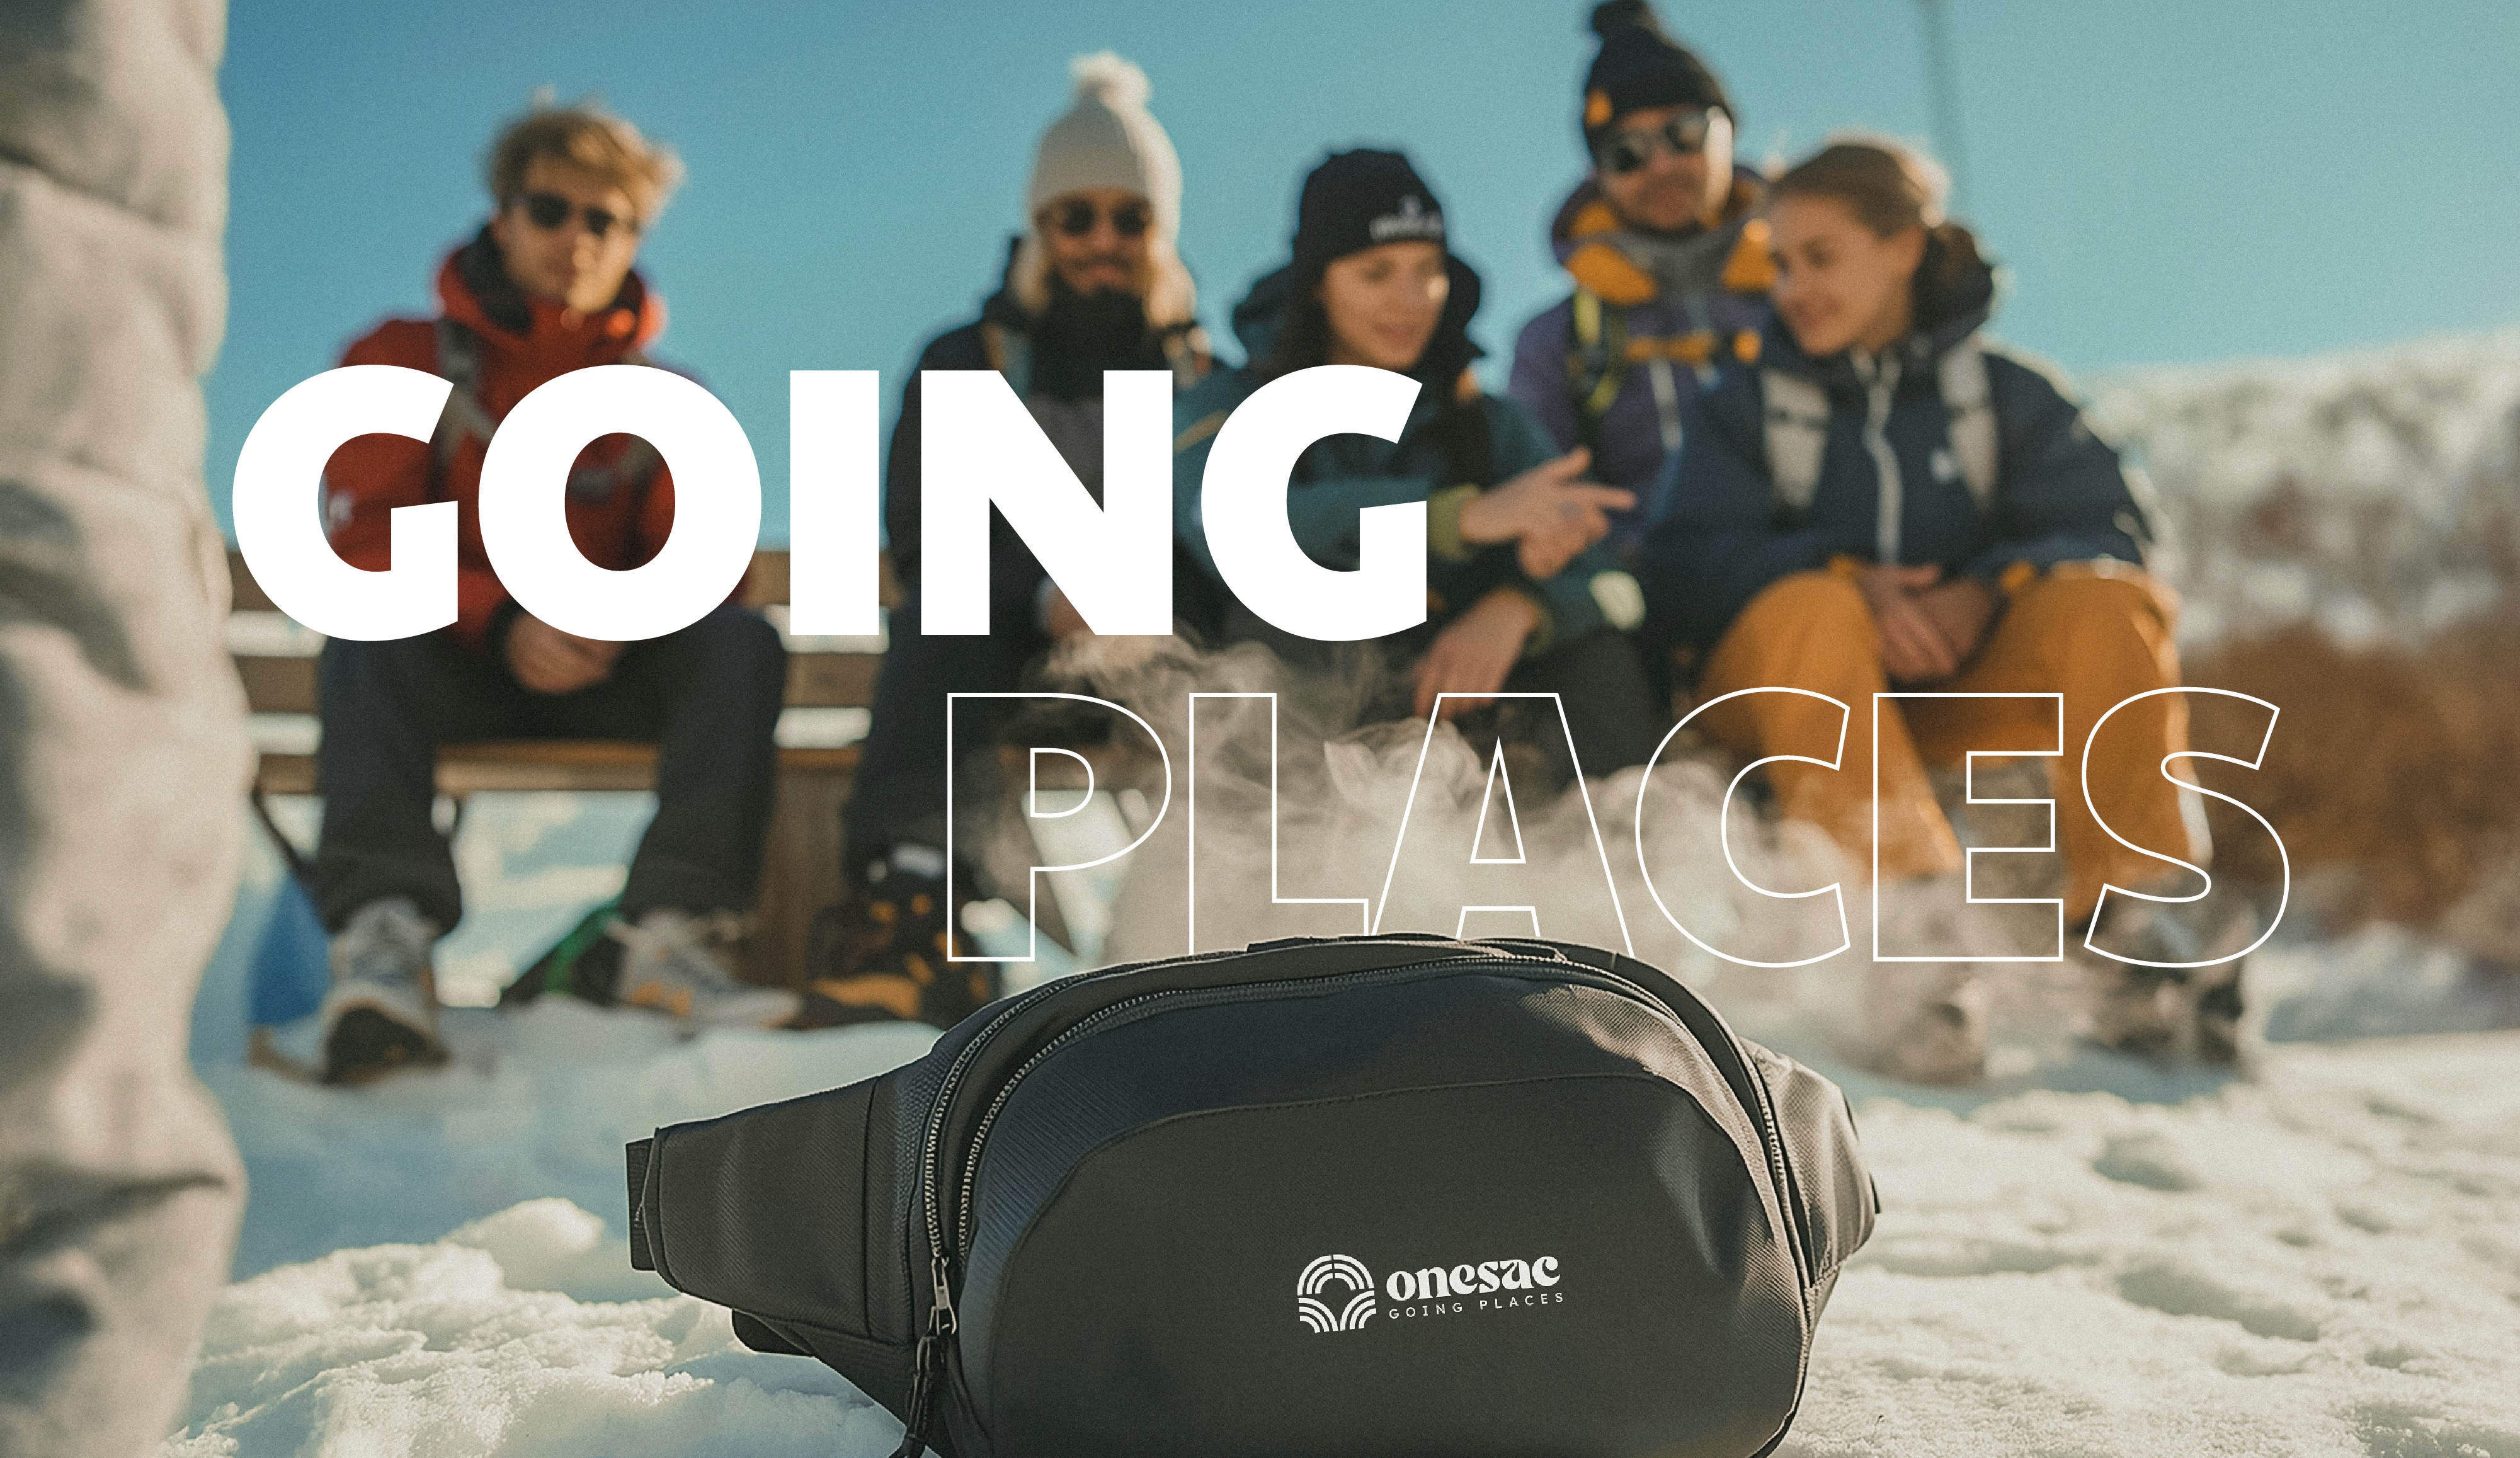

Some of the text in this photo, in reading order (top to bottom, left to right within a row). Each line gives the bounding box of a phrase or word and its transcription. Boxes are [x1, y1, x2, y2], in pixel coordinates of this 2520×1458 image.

[1386, 1256, 1561, 1301] onesac
[1389, 1292, 1563, 1319] GOING PLACES
